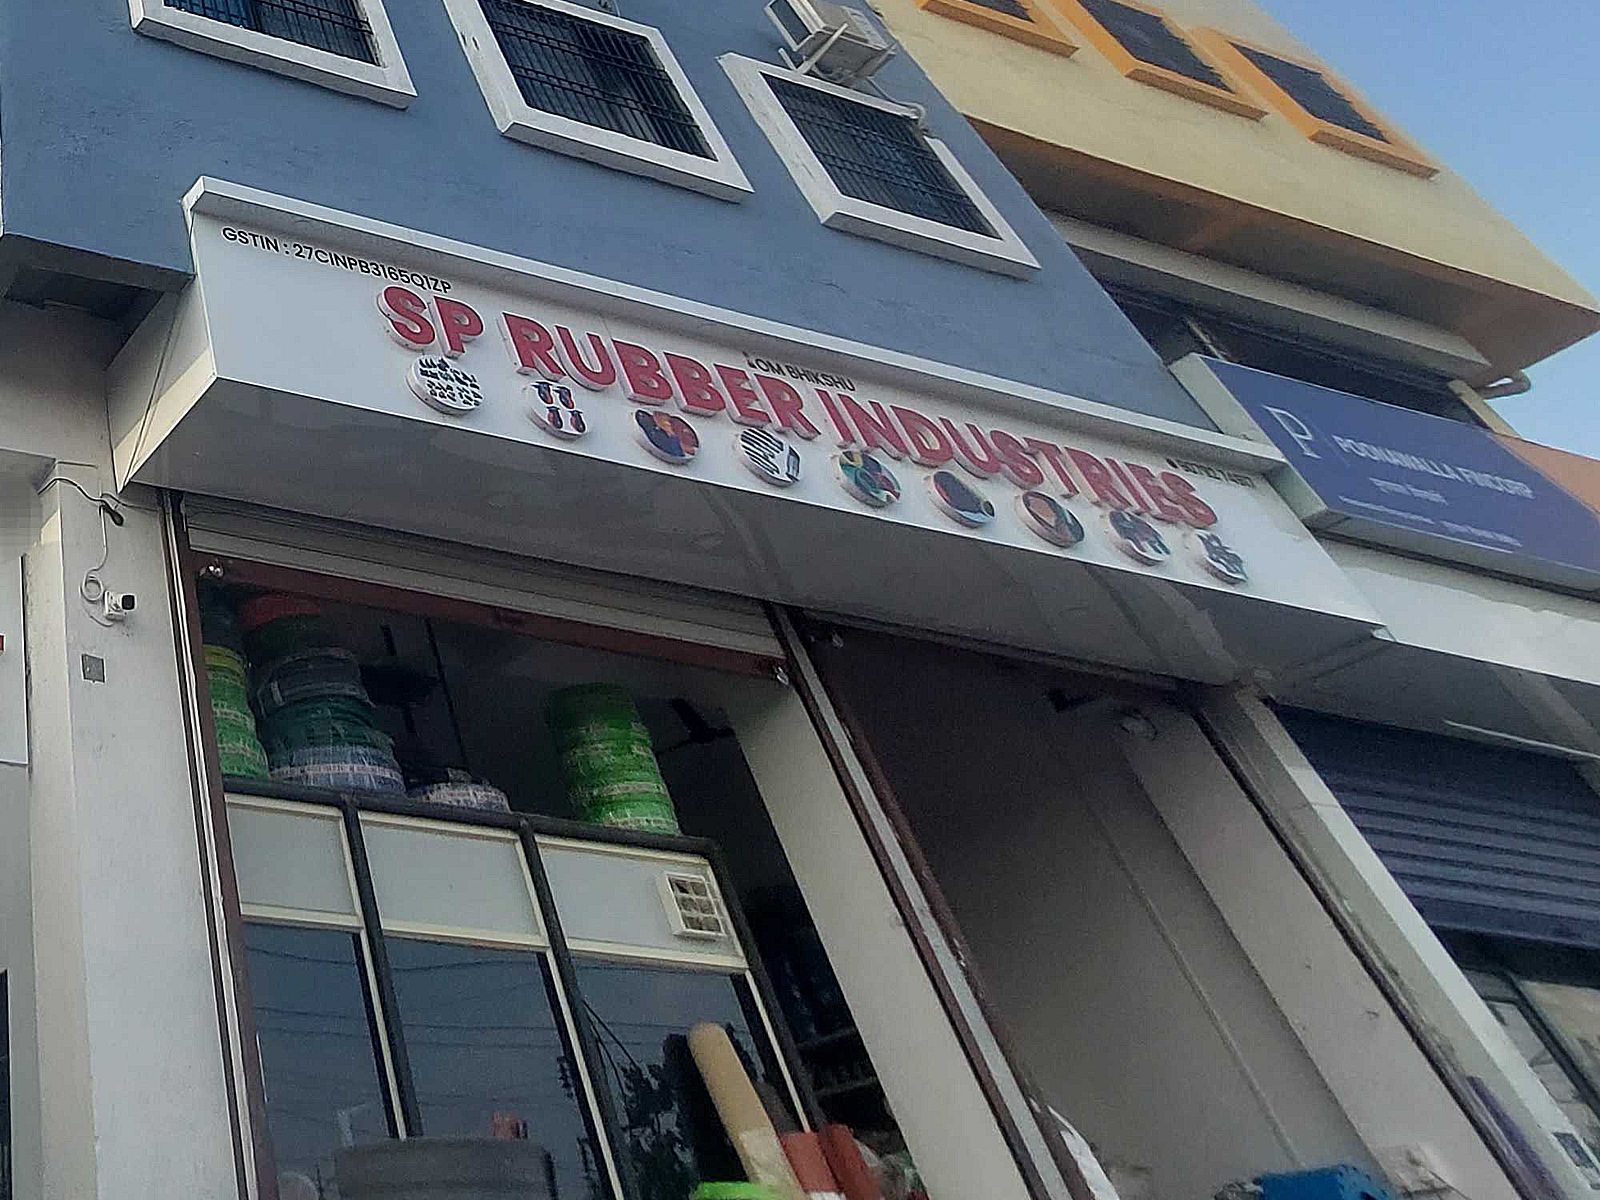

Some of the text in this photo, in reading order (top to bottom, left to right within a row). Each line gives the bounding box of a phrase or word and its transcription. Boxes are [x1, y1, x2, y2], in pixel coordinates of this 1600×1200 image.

[222, 227, 279, 253] GSTIN
[755, 358, 786, 377] OM
[380, 286, 484, 357] SP
[503, 313, 820, 439] RUBBER
[816, 388, 1220, 529] INDUSTRIES
